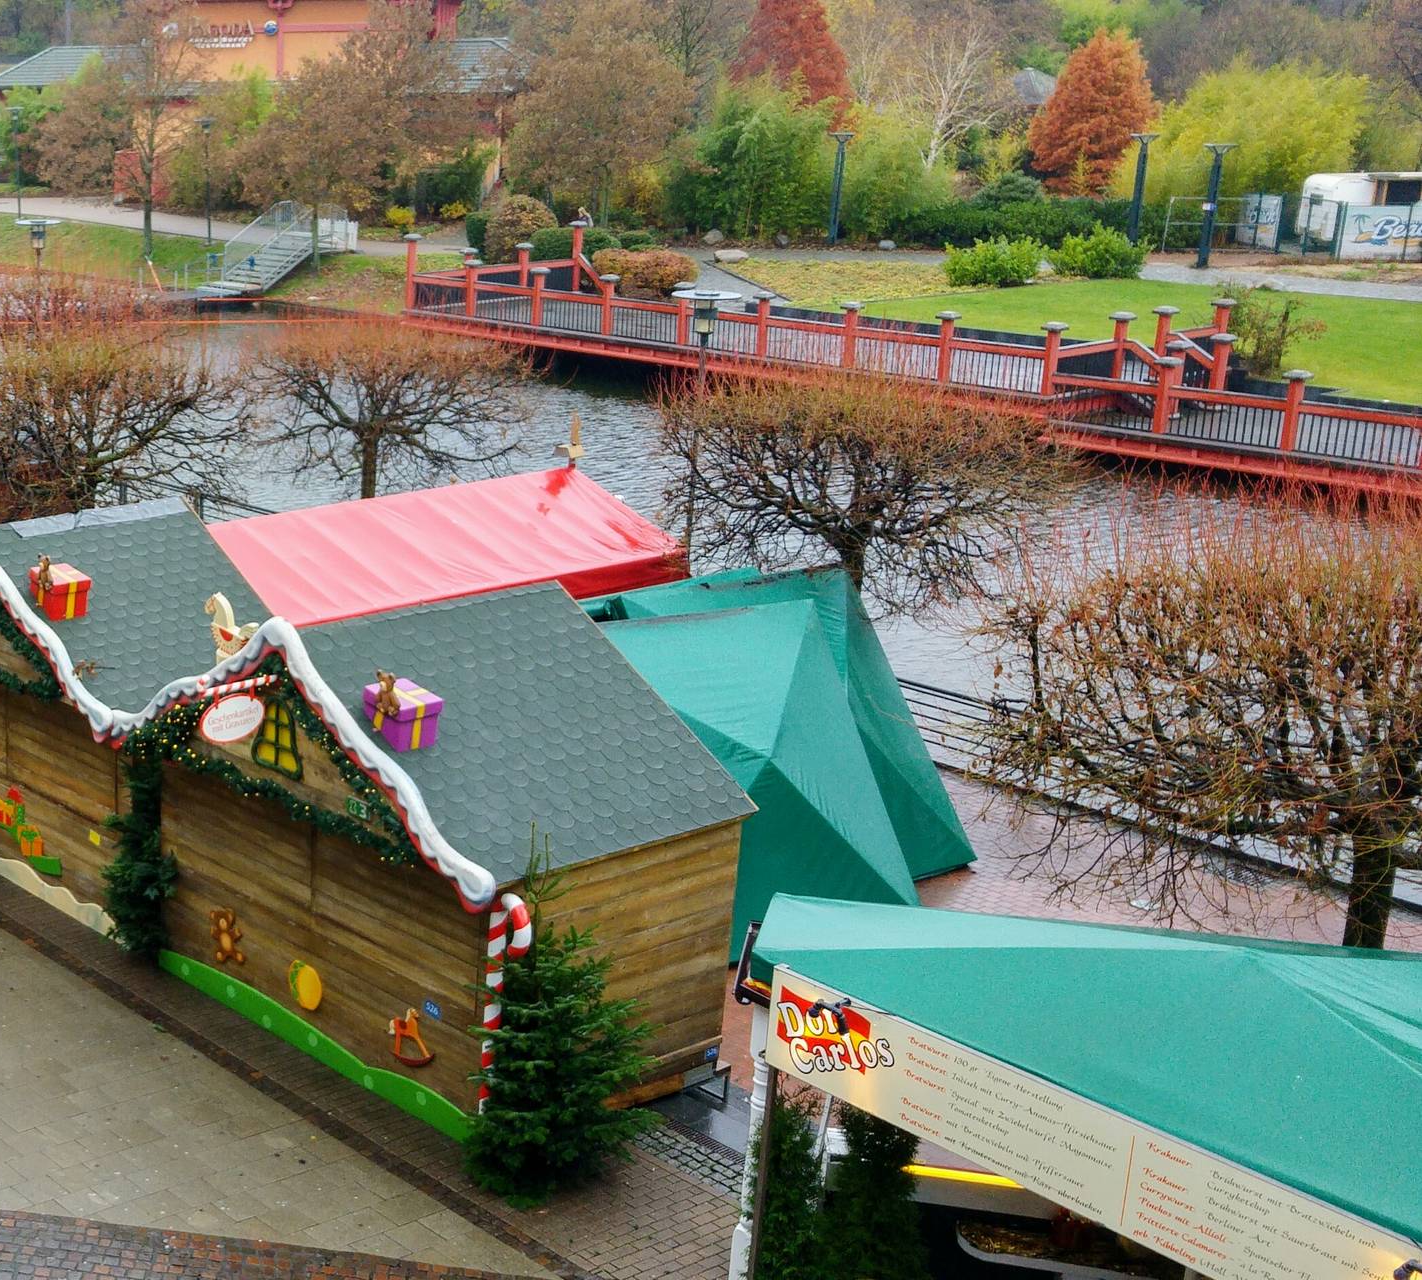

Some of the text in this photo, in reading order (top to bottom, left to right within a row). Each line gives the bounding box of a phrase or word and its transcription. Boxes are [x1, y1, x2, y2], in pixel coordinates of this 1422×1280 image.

[788, 1033, 895, 1075] Carlos
[1267, 1195, 1283, 1208] mit
[1175, 1215, 1190, 1226] mit
[1262, 1224, 1278, 1234] mit
